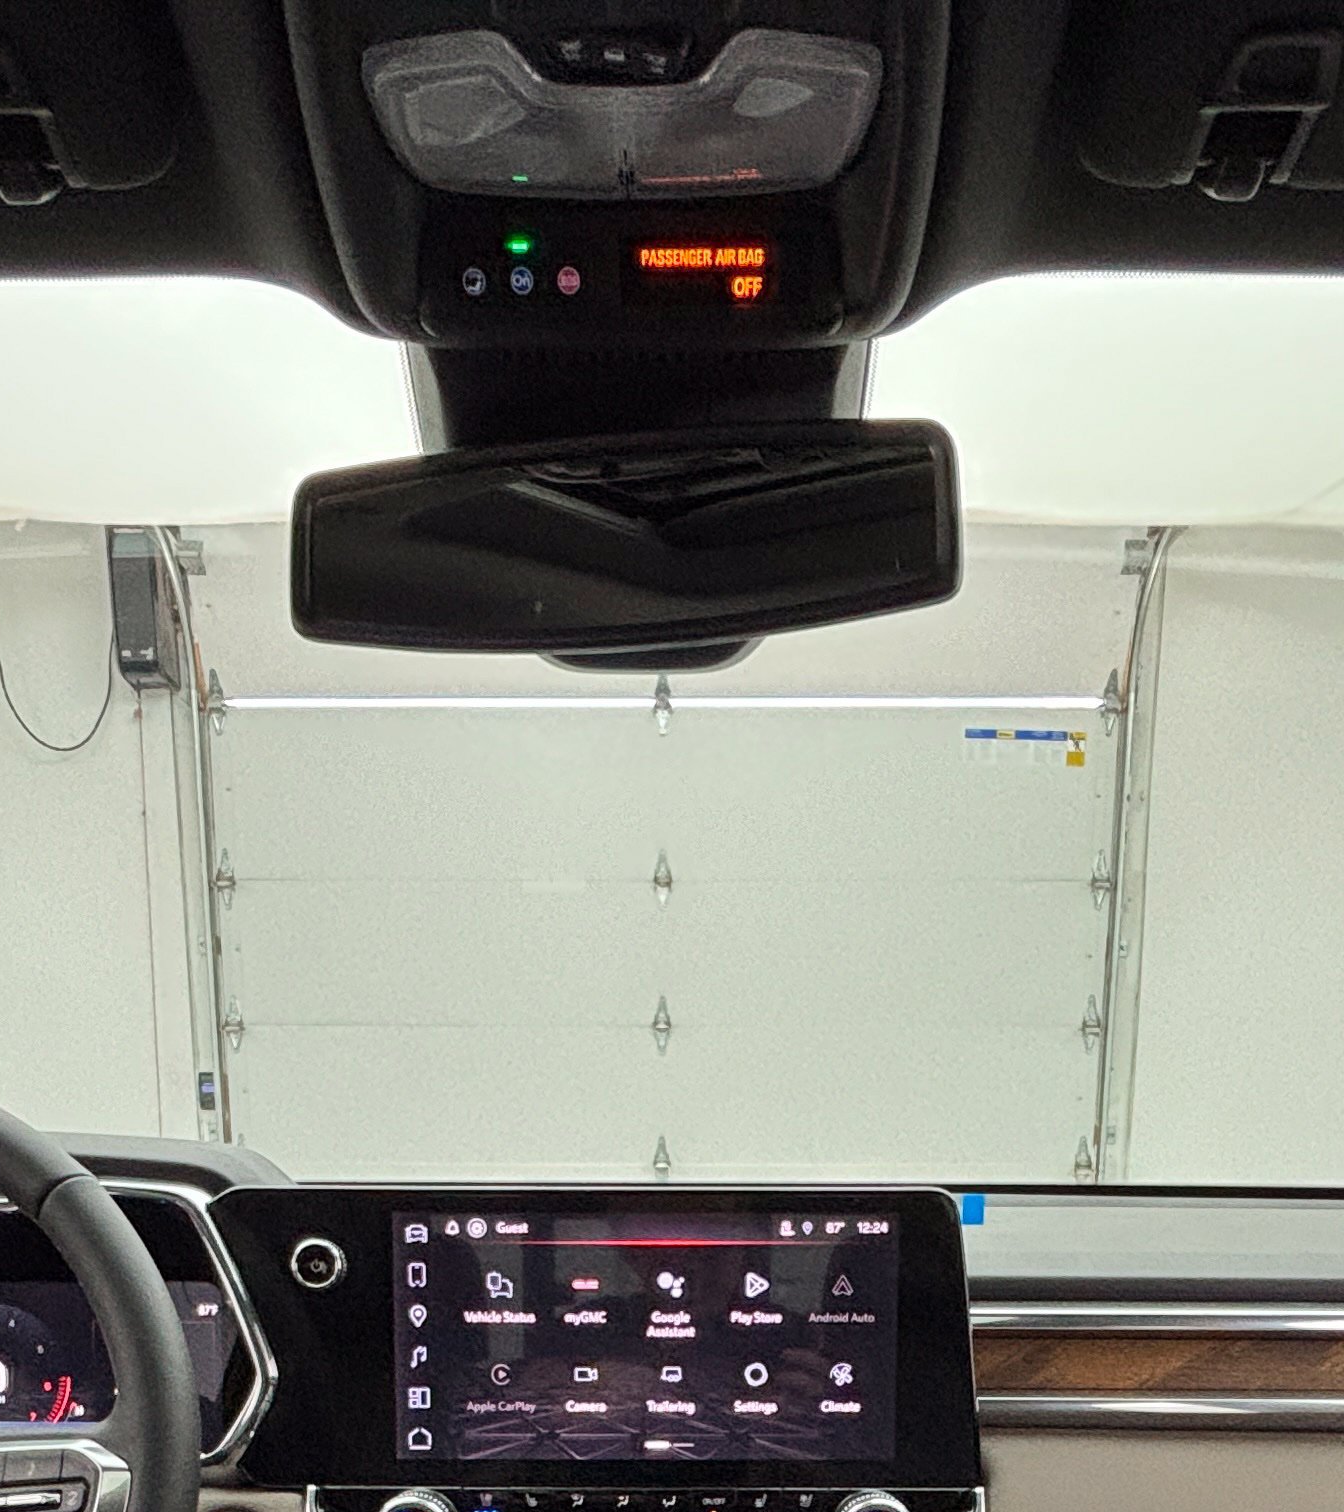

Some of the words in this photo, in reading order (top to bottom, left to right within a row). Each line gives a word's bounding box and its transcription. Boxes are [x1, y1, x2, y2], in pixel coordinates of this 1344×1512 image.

[641, 249, 712, 267] PASSENGER
[715, 249, 737, 266] AIR
[738, 248, 764, 267] BAG
[733, 277, 763, 297] OFF
[495, 1222, 529, 1235] Guest
[857, 1221, 890, 1235] 12:24
[463, 1311, 502, 1324] Vehicle
[502, 1311, 537, 1324] Status
[563, 1311, 607, 1326] myGMC
[650, 1310, 691, 1326] Google
[730, 1310, 754, 1326] Play
[754, 1311, 783, 1324] Store
[808, 1312, 849, 1324] Android
[851, 1312, 875, 1324] Auto
[646, 1325, 696, 1338] Assistant
[466, 1402, 496, 1414] Apple
[498, 1401, 535, 1414] CarPlay
[565, 1401, 607, 1413] Camera
[647, 1401, 695, 1415] Trailering
[734, 1401, 778, 1415] Settings
[820, 1401, 861, 1413] Climate
